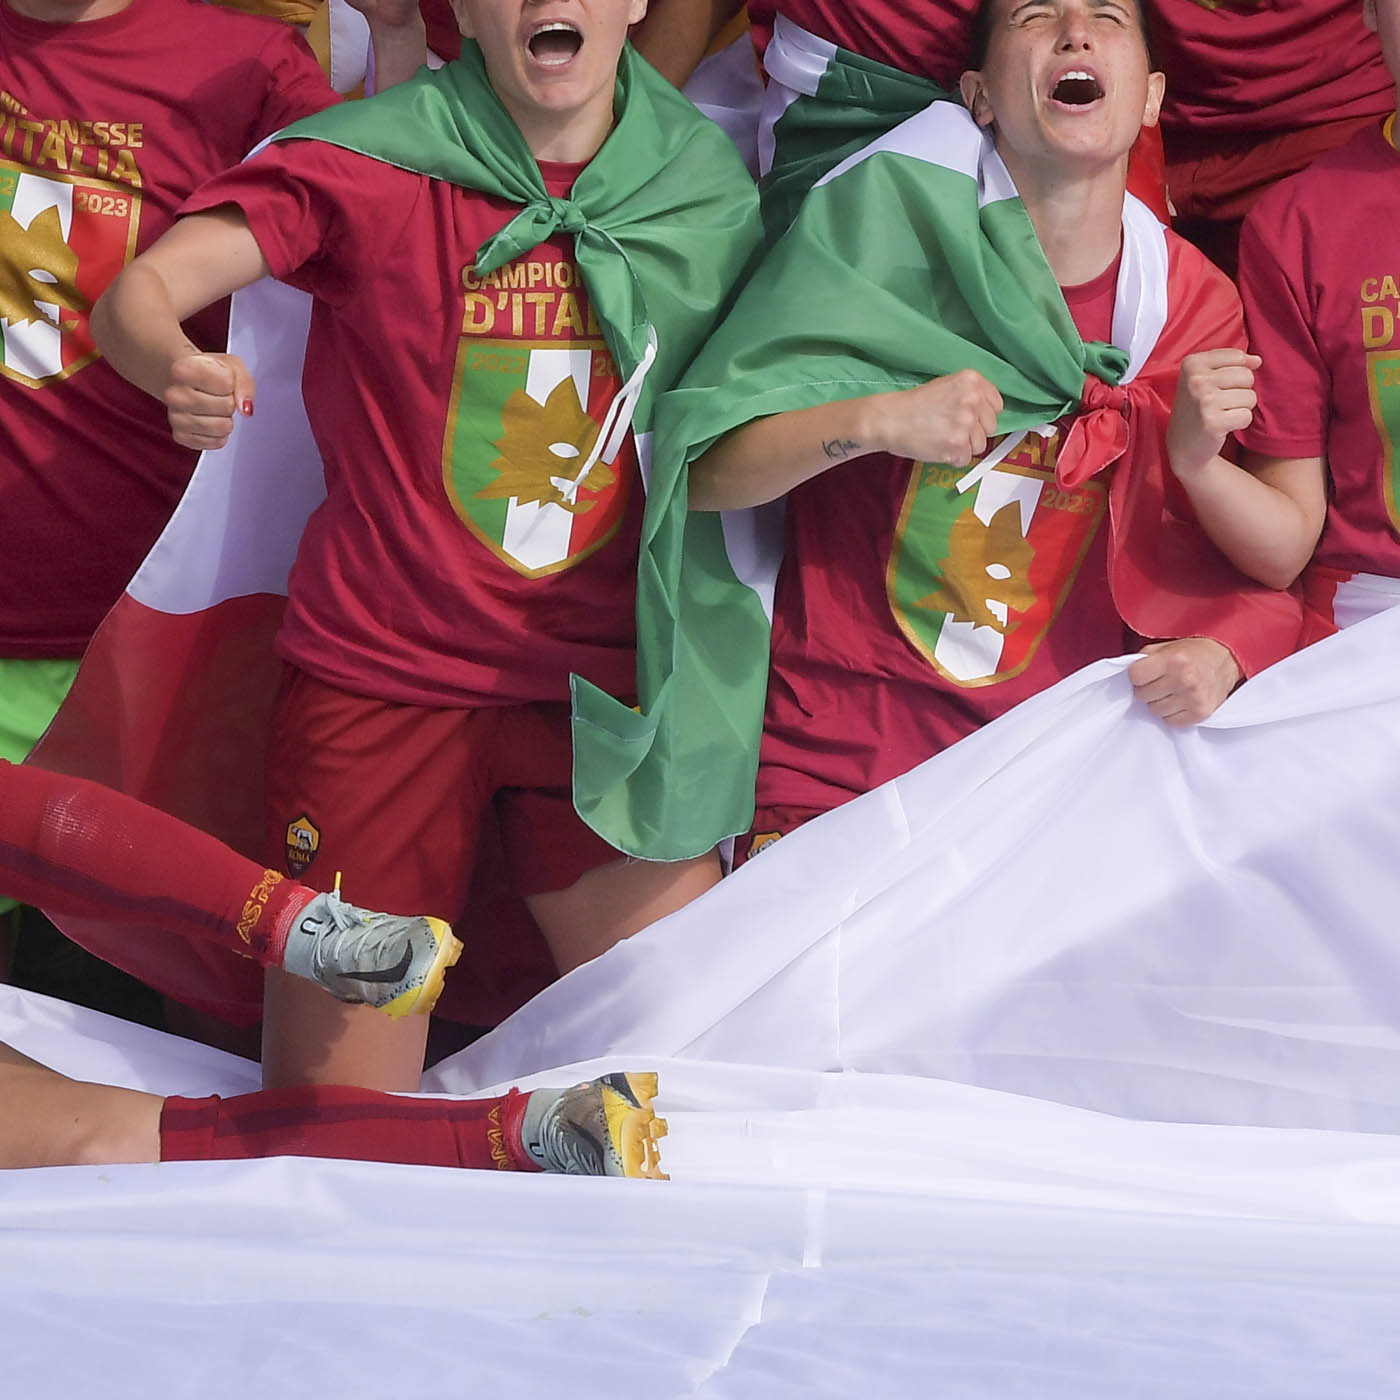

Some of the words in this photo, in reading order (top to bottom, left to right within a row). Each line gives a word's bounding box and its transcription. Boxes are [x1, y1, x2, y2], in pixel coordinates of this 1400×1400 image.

[76, 191, 129, 217] 2023
[461, 261, 583, 291] CAMPIO
[470, 352, 527, 375] 2022
